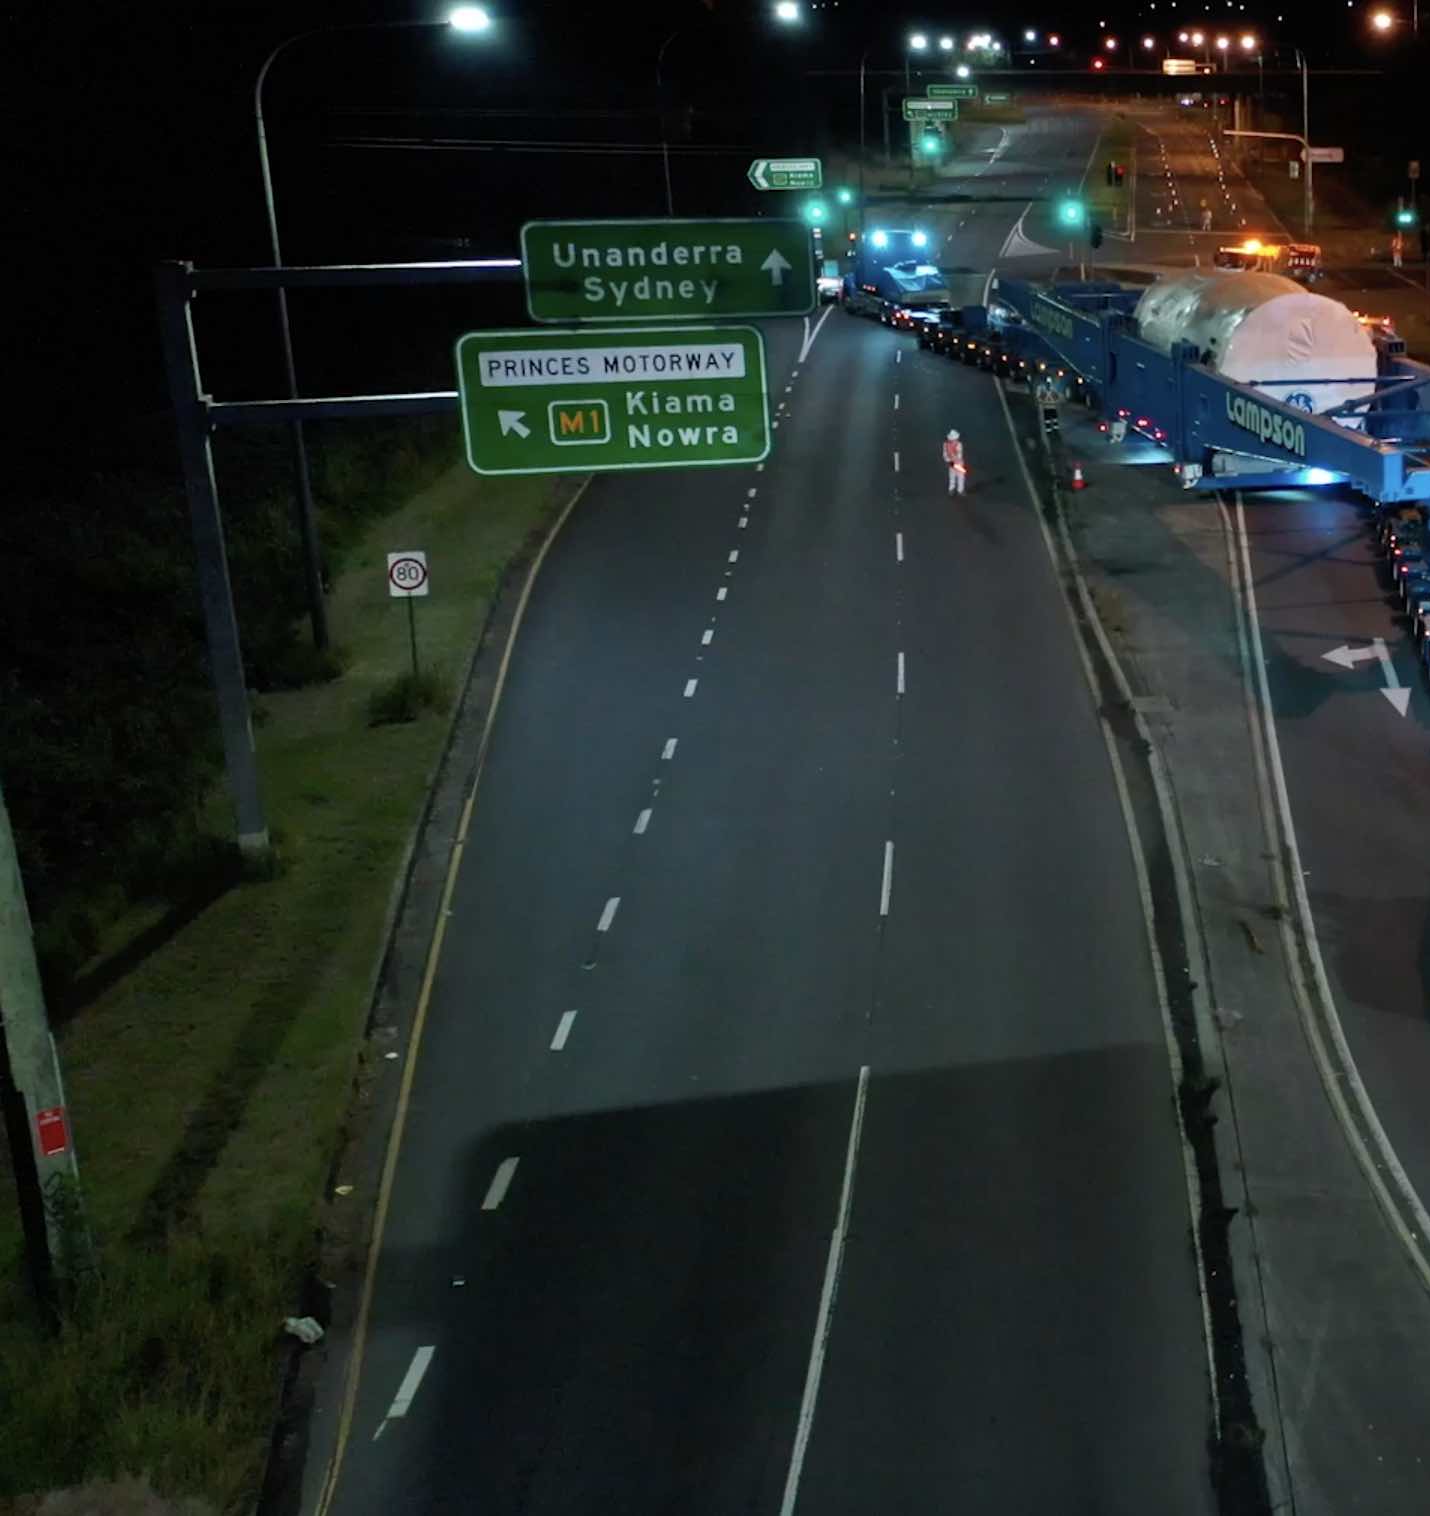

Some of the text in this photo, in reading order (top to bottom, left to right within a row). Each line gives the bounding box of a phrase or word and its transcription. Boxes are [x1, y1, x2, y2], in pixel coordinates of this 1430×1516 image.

[553, 242, 742, 267] Unanderra
[584, 276, 718, 307] Sydney
[488, 351, 735, 378] PRINCES MOTORWAY
[626, 391, 736, 415] Kiama
[559, 410, 601, 435] M1
[1226, 391, 1305, 457] Lampson
[628, 423, 738, 449] Nowra
[396, 566, 419, 581] 80
